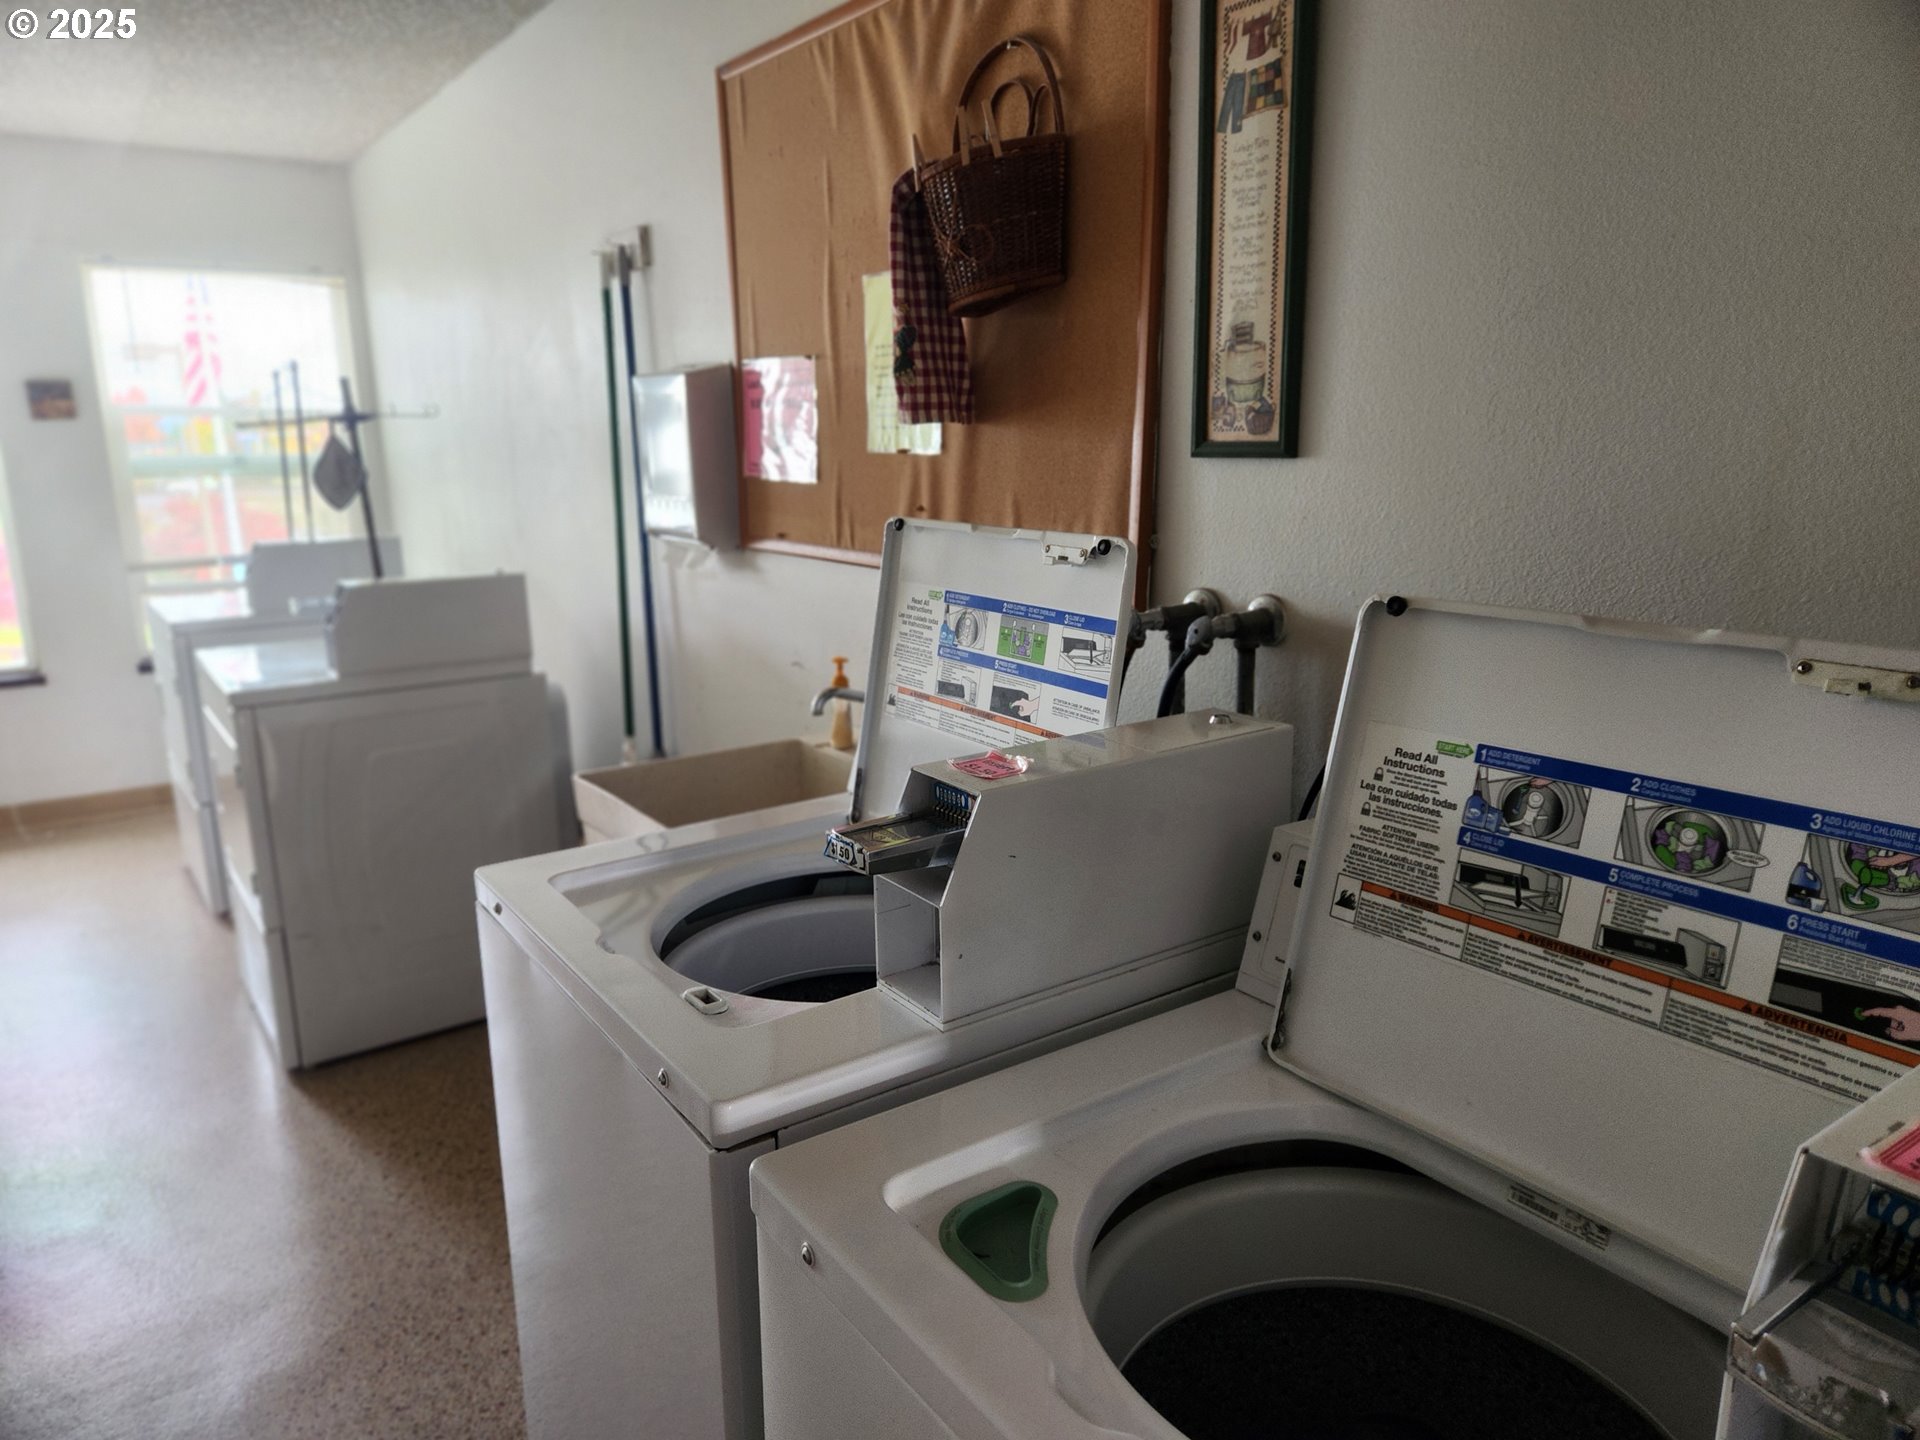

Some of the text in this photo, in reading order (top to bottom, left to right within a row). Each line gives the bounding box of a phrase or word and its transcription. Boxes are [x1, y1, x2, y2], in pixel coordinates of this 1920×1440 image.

[1002, 602, 1007, 612] 2
[1064, 614, 1069, 624] 3
[995, 659, 999, 669] 5
[1394, 747, 1423, 762] Read
[1424, 753, 1439, 766] All
[1479, 748, 1487, 762] 1
[1502, 752, 1542, 766] DETERGENT
[1383, 756, 1446, 779] Instructions
[1630, 776, 1642, 793] 2
[1642, 779, 1697, 798] ADD CLOTHES
[1360, 779, 1376, 792] Lea
[1377, 785, 1394, 796] con
[1395, 787, 1431, 805] cuidado
[1431, 796, 1458, 811] todas
[1368, 792, 1382, 803] las
[1382, 795, 1444, 819] instrucciones.
[1809, 812, 1823, 830] 3
[1823, 815, 1918, 842] ADD LIQUID CHLORINE
[1381, 824, 1418, 839] ATTENTION
[1463, 830, 1472, 845] 4
[1608, 867, 1620, 883] 5
[1619, 870, 1699, 898] COMPLETE PROCESS
[1786, 913, 1800, 931] 6
[1800, 916, 1860, 940] PRESS START
[1755, 1005, 1849, 1045] ADVERTENCIA
